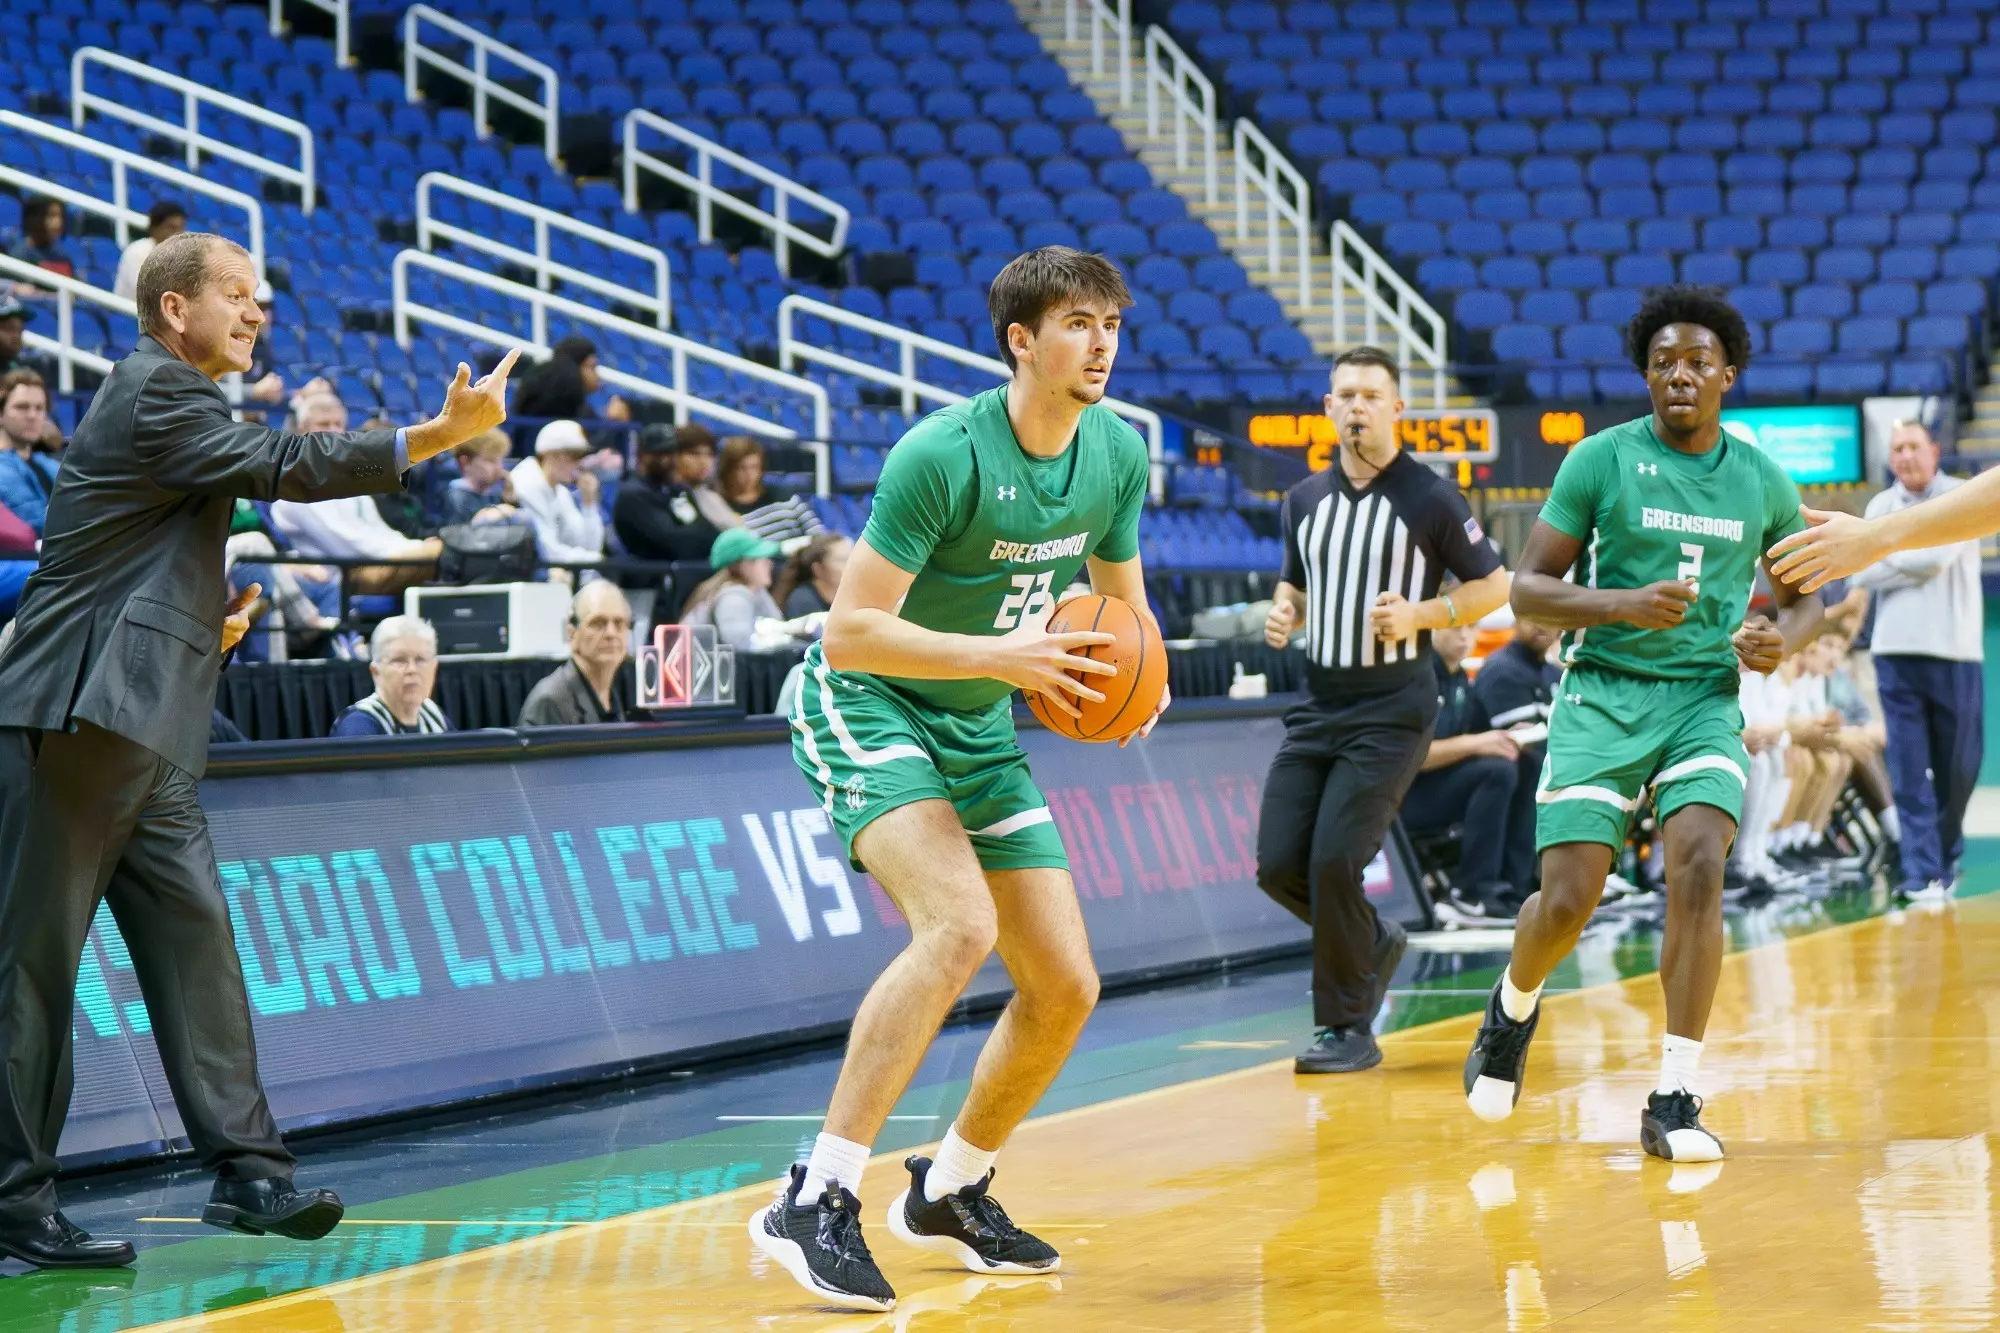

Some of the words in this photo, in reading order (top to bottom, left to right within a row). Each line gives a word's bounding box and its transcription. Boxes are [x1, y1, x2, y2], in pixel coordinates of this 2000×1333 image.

[989, 531, 1090, 564] GREENSBORO
[1641, 507, 1745, 543] GREENSBORO
[1677, 542, 1705, 596] 2
[993, 569, 1056, 629] 22
[410, 817, 760, 990] COLLEGE
[742, 807, 862, 943] VS
[1109, 775, 1259, 894] COLLE
